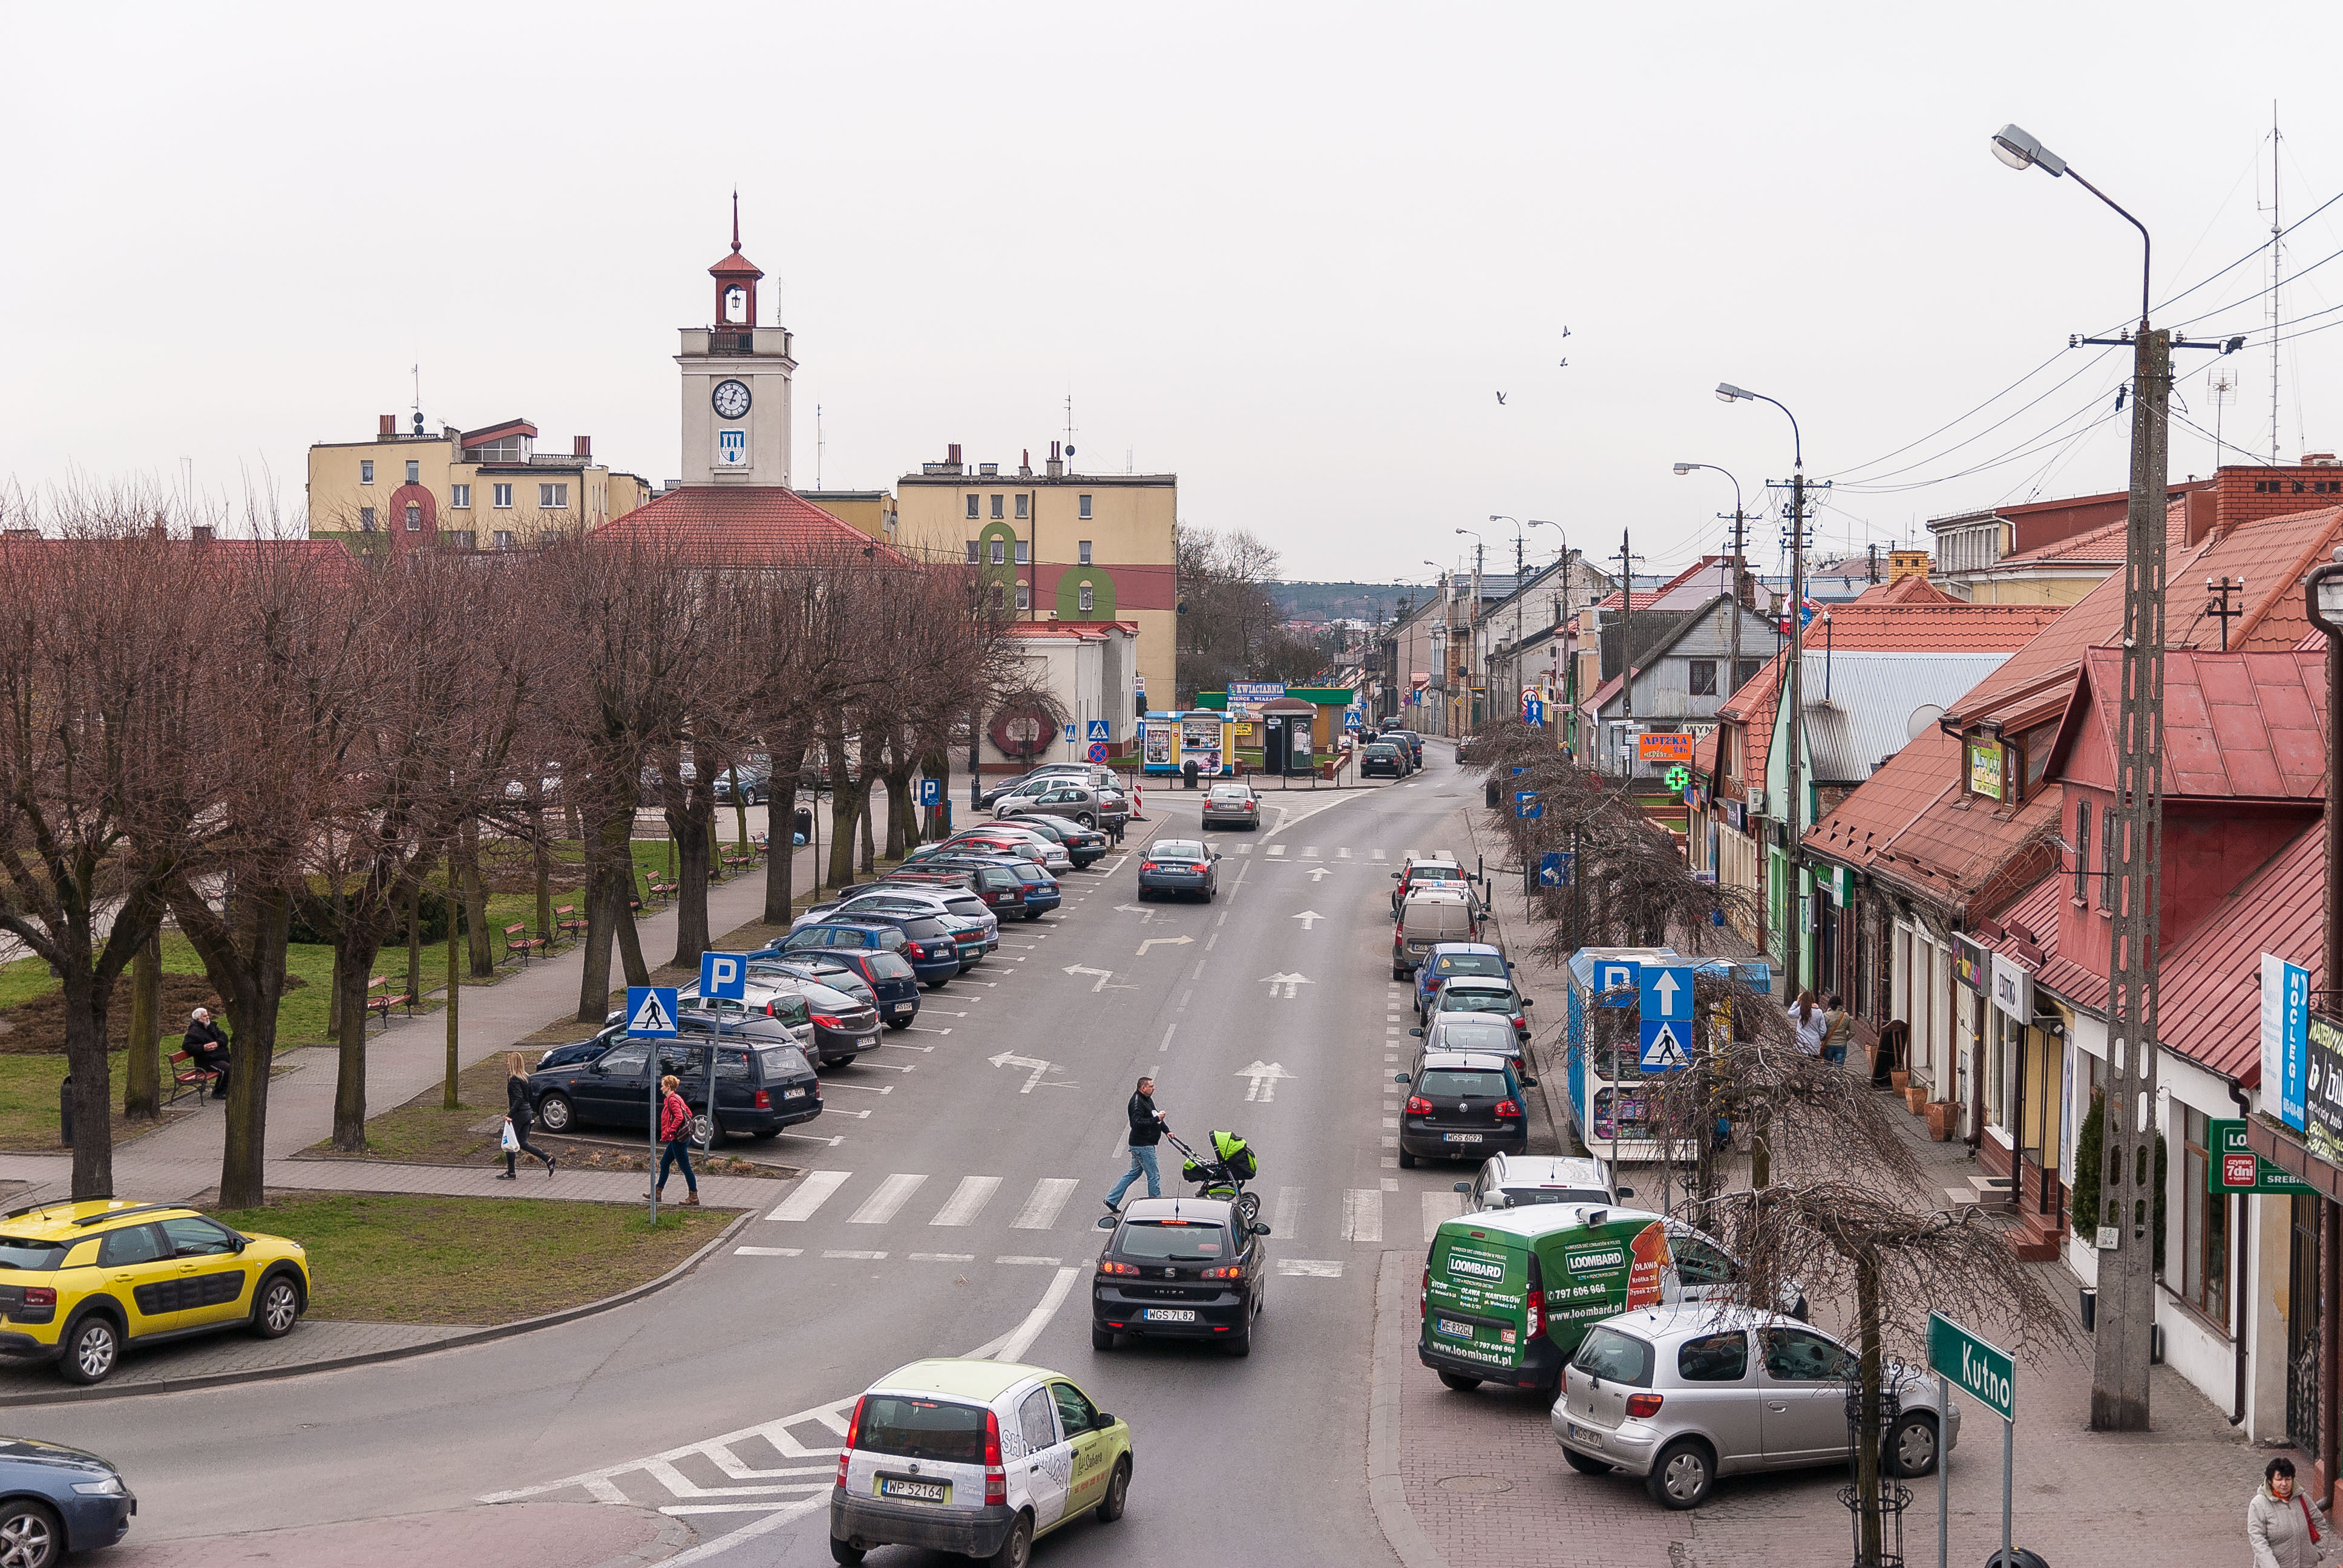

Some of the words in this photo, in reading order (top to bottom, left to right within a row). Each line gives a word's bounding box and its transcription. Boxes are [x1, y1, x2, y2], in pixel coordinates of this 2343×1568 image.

[1236, 684, 1284, 694] KWIACIARNIA
[1643, 736, 1688, 745] APTEKA
[925, 782, 936, 799] P
[710, 958, 738, 993] P
[2289, 972, 2300, 1096] NOCLEGI
[2229, 1134, 2247, 1146] LO
[1450, 1258, 1501, 1278] LOOMBARD
[1570, 1253, 1622, 1269] LOOMBARD
[1634, 1260, 1659, 1272] OŁAWA
[1431, 1281, 1448, 1290] SYCÓW
[1461, 1287, 1481, 1297] OŁAWA
[1555, 1289, 1571, 1300] 797
[1573, 1286, 1589, 1297] 606
[1590, 1283, 1606, 1294] 966
[1484, 1292, 1521, 1304] NAMYSŁÓW
[1149, 1310, 1168, 1319] WGS
[1171, 1310, 1194, 1321] 7L82
[1549, 1302, 1622, 1322] www.loombard.pl
[1441, 1319, 1451, 1328] WE
[1452, 1322, 1472, 1336] 832GL
[1432, 1341, 1512, 1366] www.loombard.pl
[1479, 1341, 1490, 1350] 797
[1963, 1341, 2010, 1408] Kutno
[1575, 1425, 1587, 1440] WGS
[1588, 1432, 1602, 1446] 4K71
[1085, 1452, 1103, 1471] Sahara
[889, 1480, 905, 1494] WP
[908, 1483, 943, 1499] 52164
